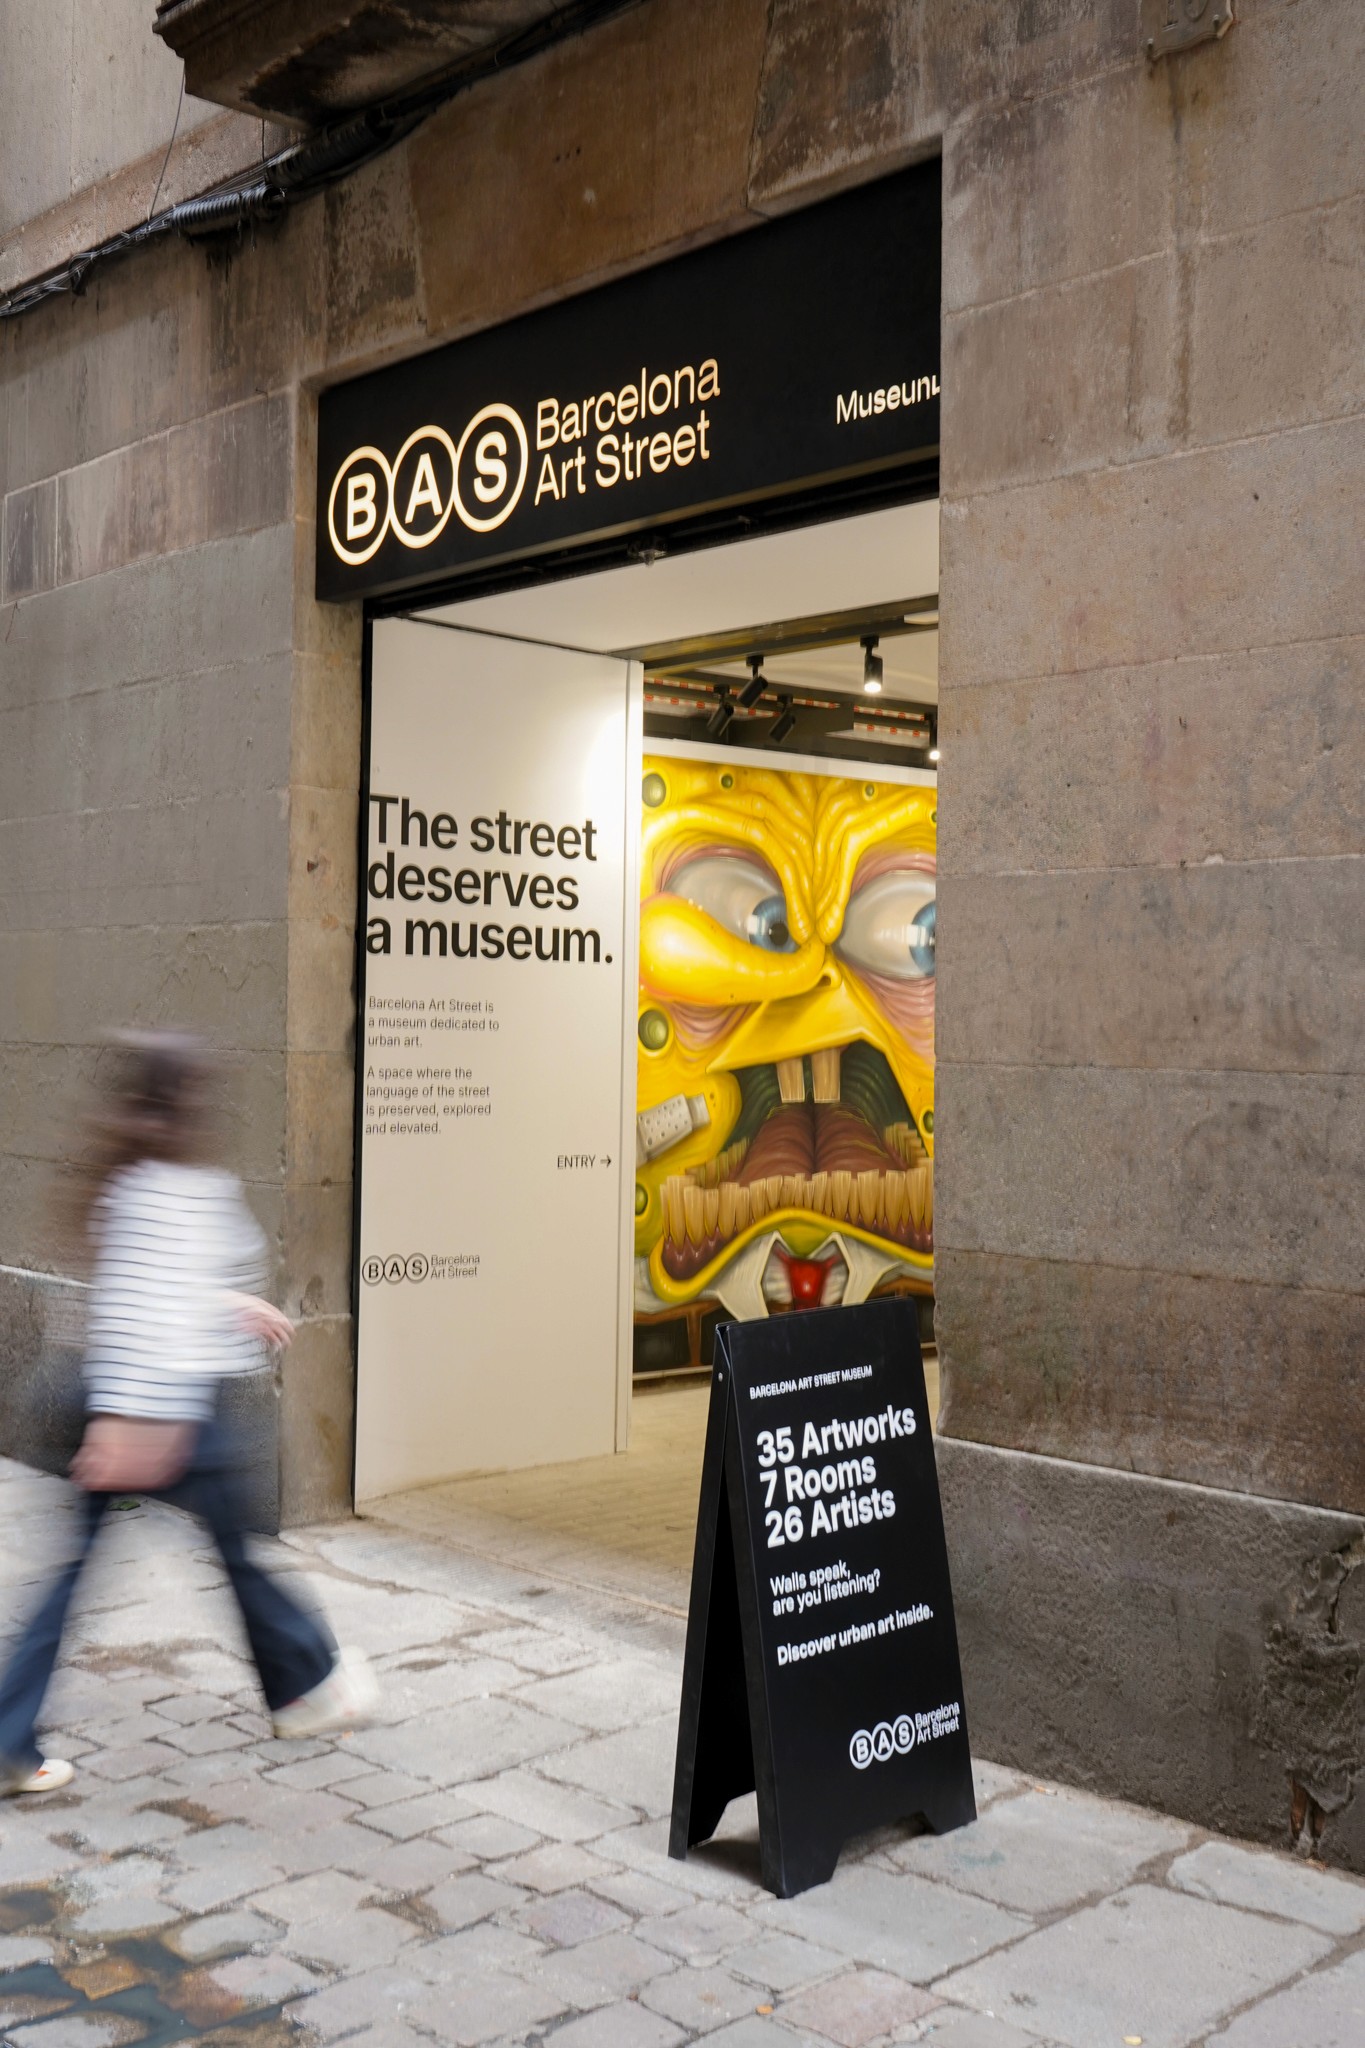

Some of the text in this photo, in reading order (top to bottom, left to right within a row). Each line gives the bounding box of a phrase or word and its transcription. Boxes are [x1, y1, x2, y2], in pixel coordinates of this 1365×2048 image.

[345, 358, 721, 543] BAS Barcelona
[534, 410, 711, 506] Art Street
[369, 793, 597, 861] The street
[368, 852, 580, 911] deserves
[366, 917, 613, 963] a museum.
[369, 996, 494, 1013] Barcelona Art Street is
[368, 1017, 499, 1031] a museum dedicated to
[368, 1034, 422, 1048] urban art.
[367, 1066, 472, 1081] A space where the
[366, 1084, 490, 1100] language of the street
[365, 1121, 441, 1135] and elevated.
[366, 1103, 491, 1118] is preserved, explored
[557, 1155, 596, 1169] ENTRY
[431, 1254, 480, 1266] Barcelona
[431, 1265, 478, 1279] Art Street
[749, 1365, 873, 1400] BARCELONA ART STREET MUSEUM
[756, 1404, 917, 1467] 35 Artworks
[759, 1455, 877, 1508] 7 Rooms
[765, 1488, 896, 1549] 26 Artists
[770, 1559, 851, 1597] Walls speak,
[773, 1568, 881, 1616] are you listening?
[777, 1603, 933, 1666] Discover urban art inside.
[855, 1702, 960, 1762] BAS Barcelona
[917, 1716, 960, 1745] Art Street
